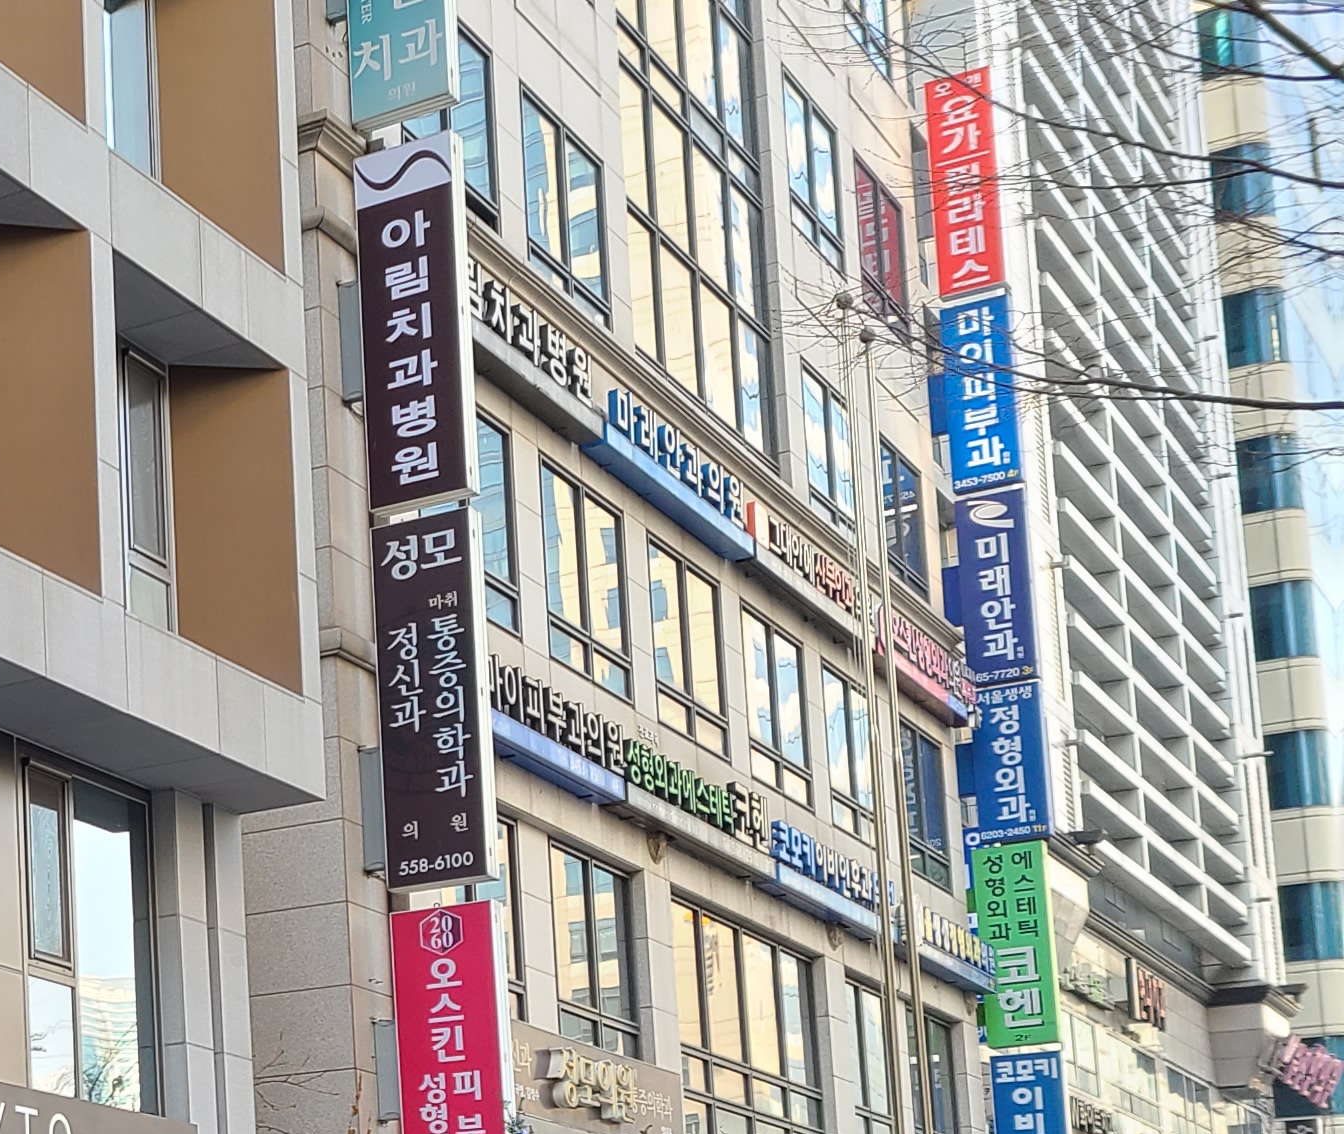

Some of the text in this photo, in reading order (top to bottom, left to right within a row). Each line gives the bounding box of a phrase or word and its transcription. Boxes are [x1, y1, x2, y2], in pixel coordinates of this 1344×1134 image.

[354, 19, 442, 81] 치과
[388, 81, 417, 100] 의원
[379, 208, 440, 486] 아림치과병원
[956, 305, 1006, 468] 마이피부과
[954, 471, 1006, 491] 3453-7500
[380, 527, 462, 581] 성모
[428, 591, 459, 610] 마취
[973, 532, 1019, 662] 미래안과
[387, 621, 427, 734] 정신과
[426, 611, 474, 799] 통증의학과
[989, 706, 1030, 823] 정형외과
[398, 851, 474, 876] 558-6100
[983, 854, 1012, 941] 성형외과
[1010, 850, 1040, 938] 에스테틱
[426, 957, 466, 1063] 오스킨
[997, 945, 1044, 1029] 코헨
[995, 1057, 1059, 1084] 코모키
[1014, 1033, 1031, 1042] 2F
